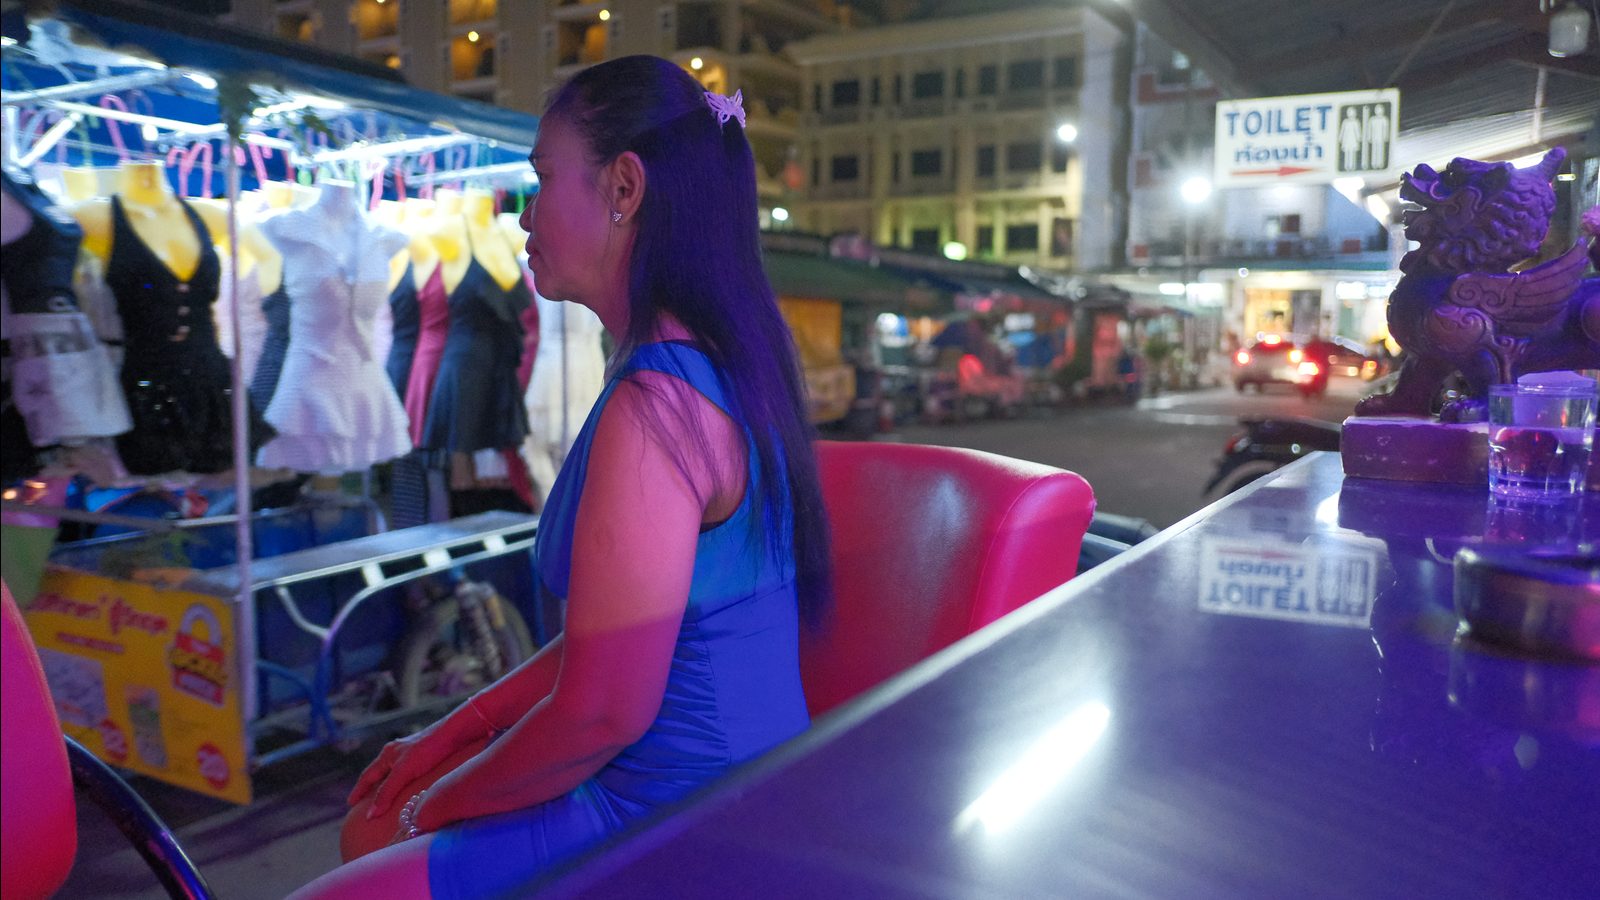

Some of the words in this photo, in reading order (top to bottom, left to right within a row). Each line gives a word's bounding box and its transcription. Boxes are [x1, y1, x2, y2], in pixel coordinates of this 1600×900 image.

[1224, 105, 1333, 137] TOILET
[1235, 132, 1324, 162] ห้องน้ำ
